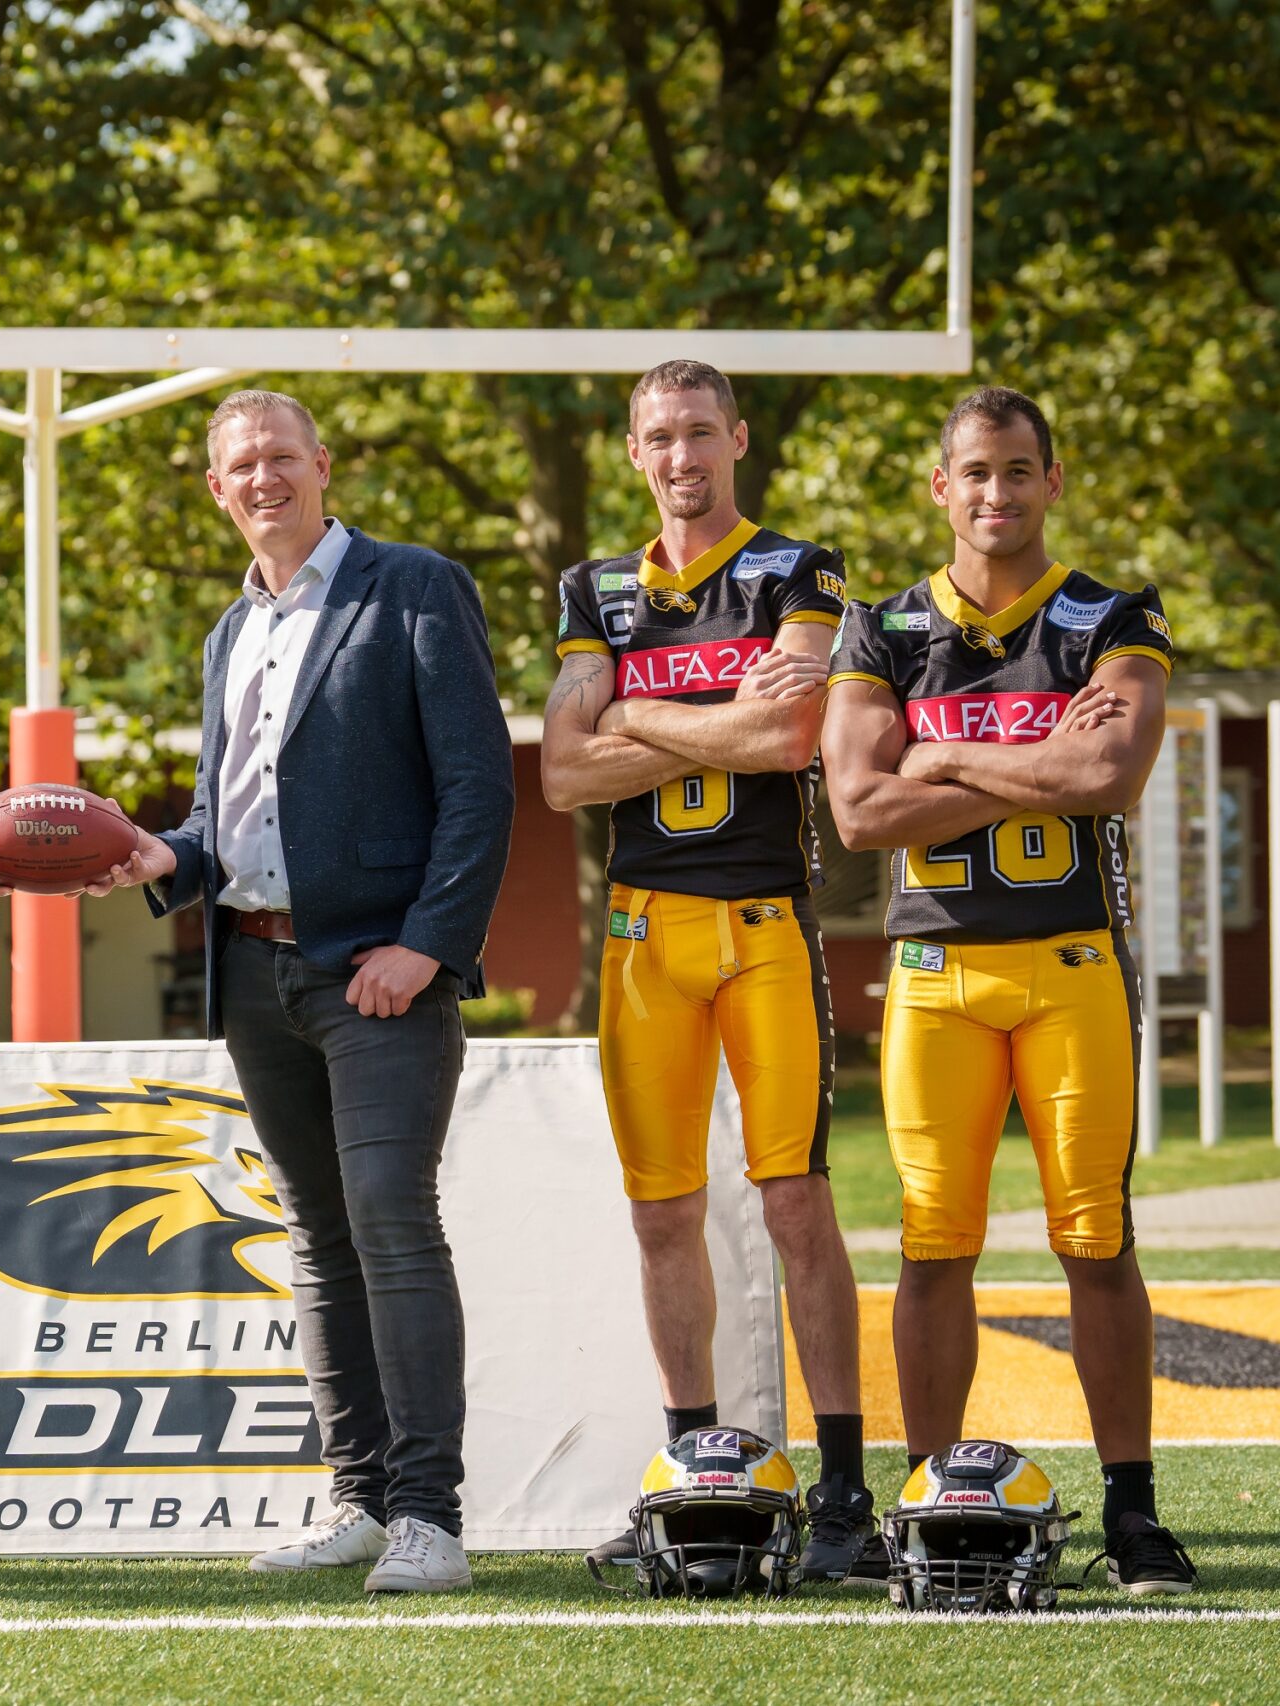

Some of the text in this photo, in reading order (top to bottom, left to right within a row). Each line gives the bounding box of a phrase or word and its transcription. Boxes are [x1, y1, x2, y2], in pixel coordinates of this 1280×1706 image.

[741, 555, 778, 566] Allianz
[822, 575, 848, 606] 197
[1057, 600, 1098, 616] Allianz
[623, 646, 761, 696] ALFA24
[917, 701, 1058, 742] ALFA24
[14, 820, 80, 836] Wilson
[34, 1321, 297, 1353] BERLIN
[698, 1474, 734, 1483] Riddell
[944, 1493, 990, 1503] Riddell
[969, 1552, 1003, 1560] SPEEDFLEX
[951, 1595, 976, 1603] Rddell
